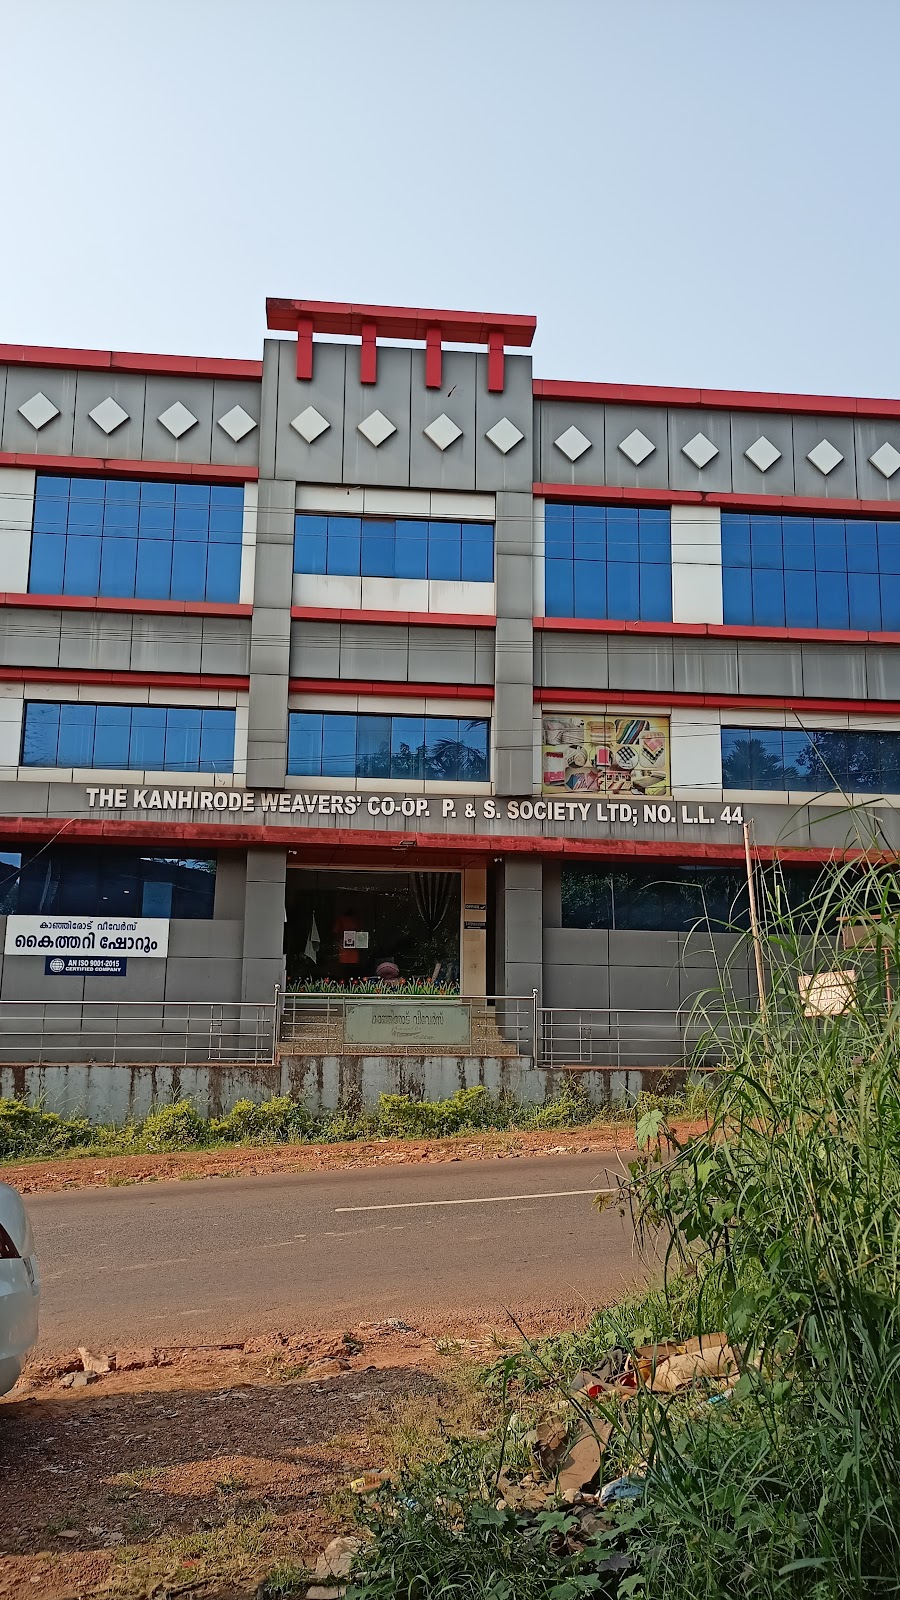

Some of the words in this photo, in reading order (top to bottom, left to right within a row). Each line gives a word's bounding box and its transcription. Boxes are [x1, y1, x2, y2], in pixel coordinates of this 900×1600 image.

[86, 788, 128, 808] THE
[133, 789, 255, 812] KANHIRODE
[367, 796, 430, 817] CO-OP.
[442, 799, 457, 818] P.
[464, 803, 477, 818] &
[483, 800, 501, 819] S.
[507, 801, 592, 821] SOCIETY
[596, 803, 638, 826] LTD;
[643, 804, 676, 823] NO.
[682, 805, 715, 824] L.L.
[720, 806, 744, 825] 44
[15, 932, 96, 949] കൈത്തറി
[100, 936, 158, 953] ഷോറൂം
[68, 959, 77, 967] AN
